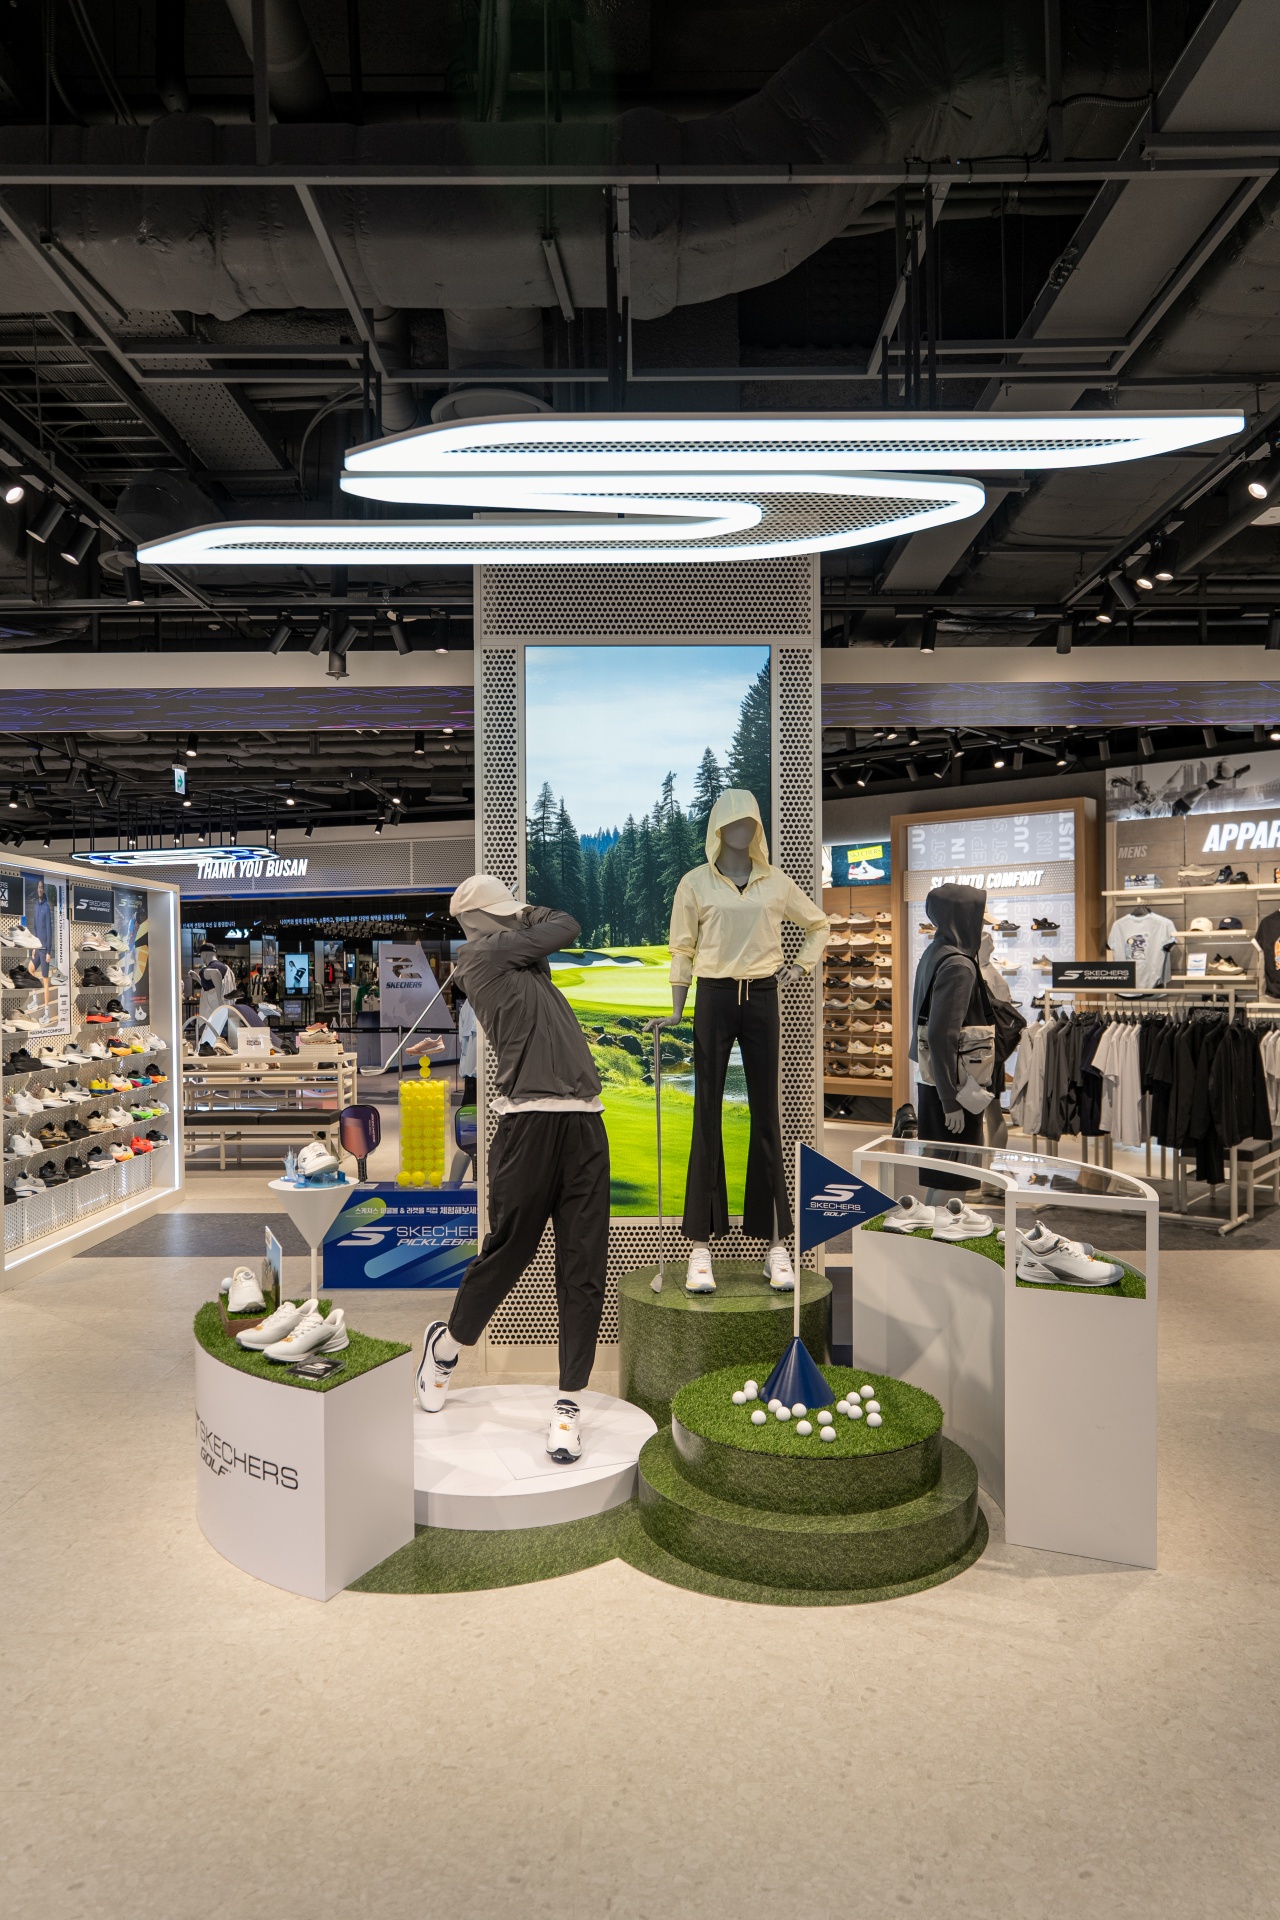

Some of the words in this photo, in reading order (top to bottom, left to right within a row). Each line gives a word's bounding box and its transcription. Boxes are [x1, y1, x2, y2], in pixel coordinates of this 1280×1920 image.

[951, 837, 966, 860] IN
[1117, 845, 1148, 859] MENS
[196, 861, 237, 880] THANK
[239, 860, 264, 878] YOU
[265, 858, 308, 878] BUSAN
[986, 870, 1044, 888] COMFORT
[385, 981, 423, 989] SKECHERS
[440, 1206, 478, 1215] 체험해보세
[810, 1201, 861, 1211] SKECHERS
[200, 1420, 299, 1490] SKECHERS
[200, 1446, 229, 1476] GOLF
